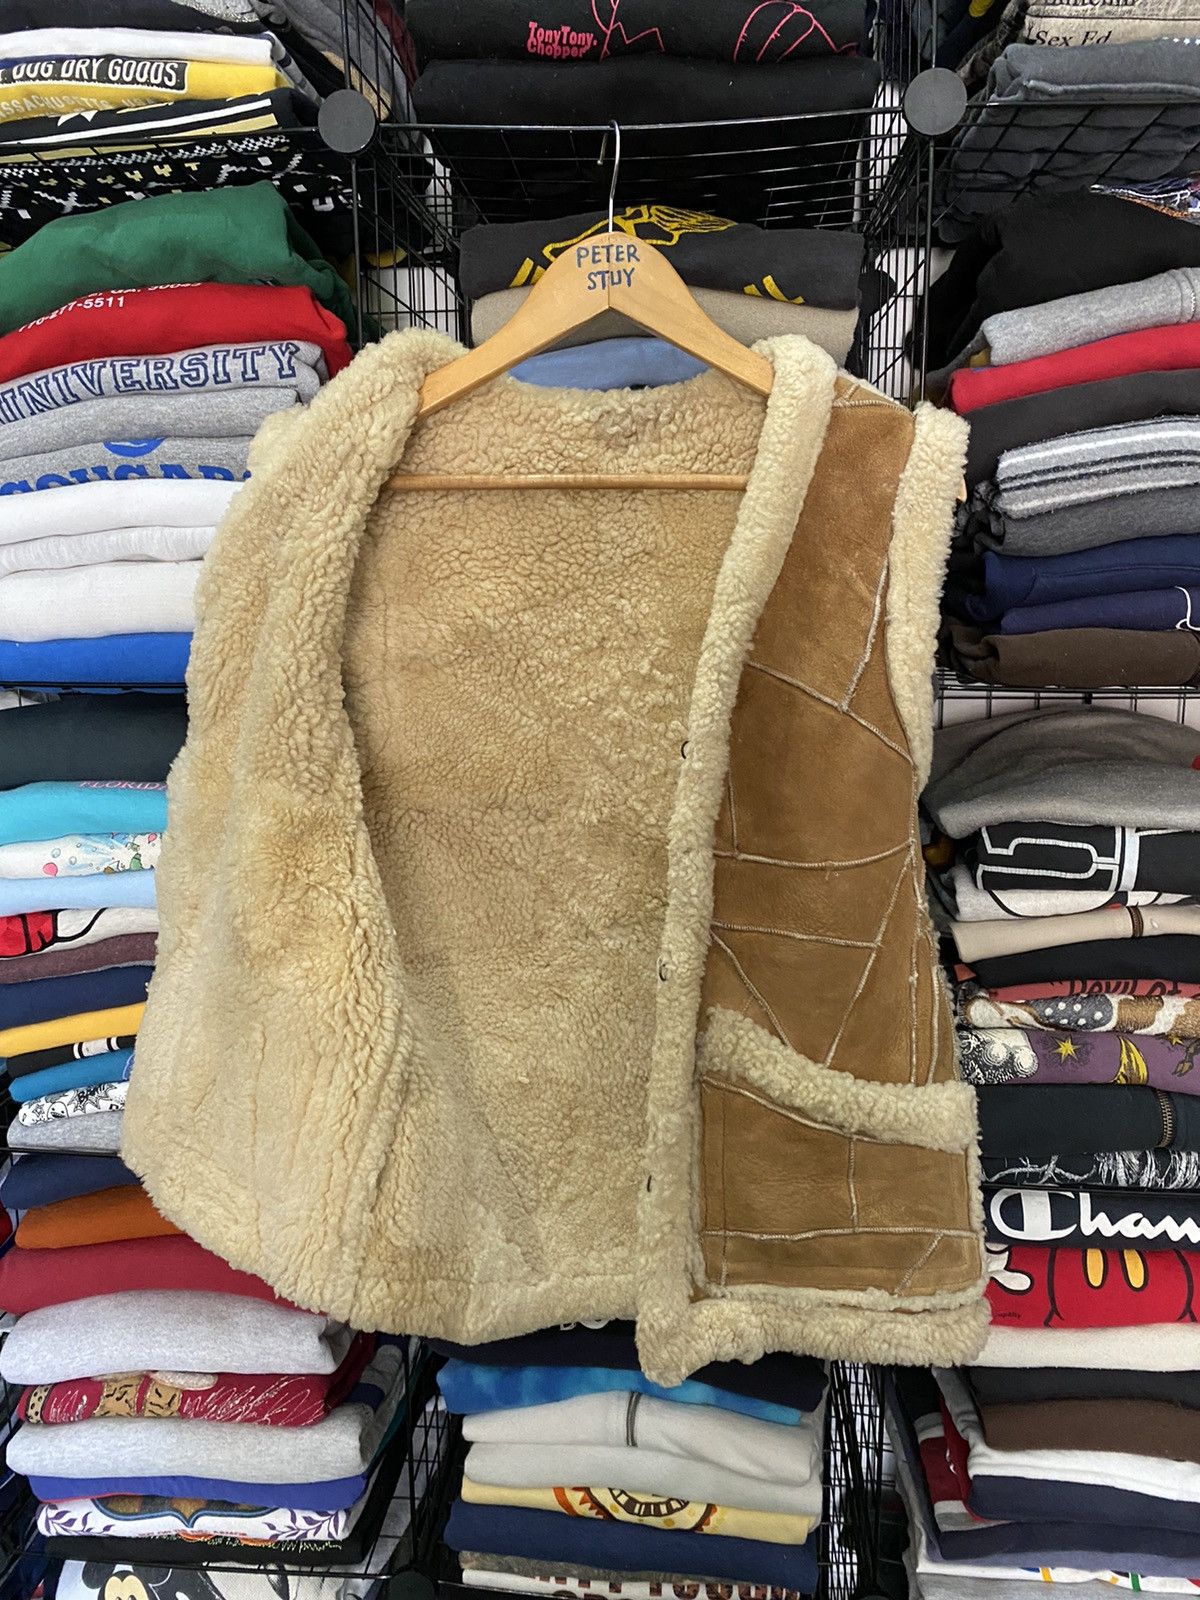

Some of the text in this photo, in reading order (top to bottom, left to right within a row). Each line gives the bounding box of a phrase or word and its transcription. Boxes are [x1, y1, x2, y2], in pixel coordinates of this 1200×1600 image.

[1036, 30, 1074, 47] Sex
[61, 58, 105, 80] DRY
[108, 58, 178, 87] GOODS
[576, 243, 641, 269] PETER
[587, 267, 635, 291] STUY
